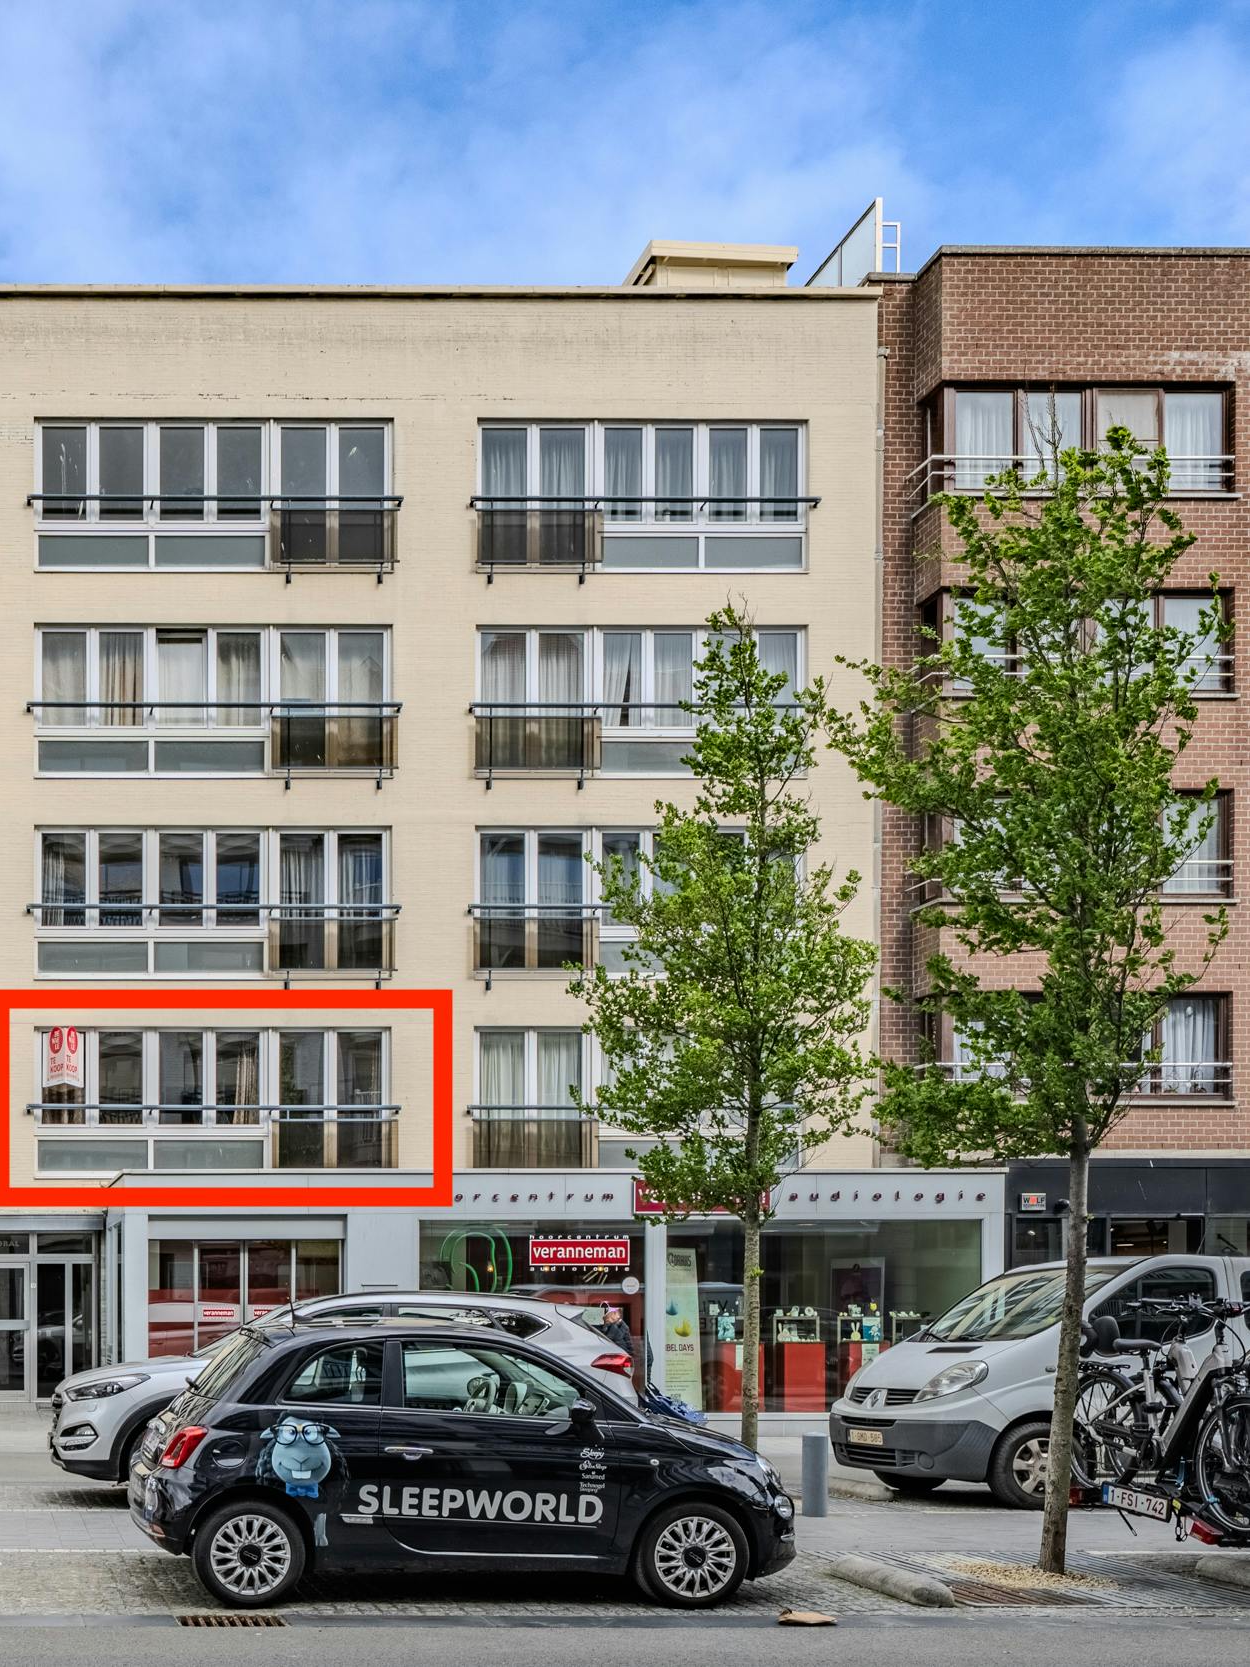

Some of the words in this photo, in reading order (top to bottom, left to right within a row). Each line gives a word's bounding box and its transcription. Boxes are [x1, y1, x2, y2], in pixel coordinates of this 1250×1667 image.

[50, 1056, 56, 1065] TE
[66, 1054, 71, 1063] TE
[50, 1063, 63, 1073] KOOP
[66, 1063, 78, 1073] KOOP
[788, 1190, 986, 1204] audiologie
[533, 1246, 626, 1259] veranneman
[679, 1343, 695, 1352] DAYS
[357, 1484, 604, 1524] SLEEPWORLD
